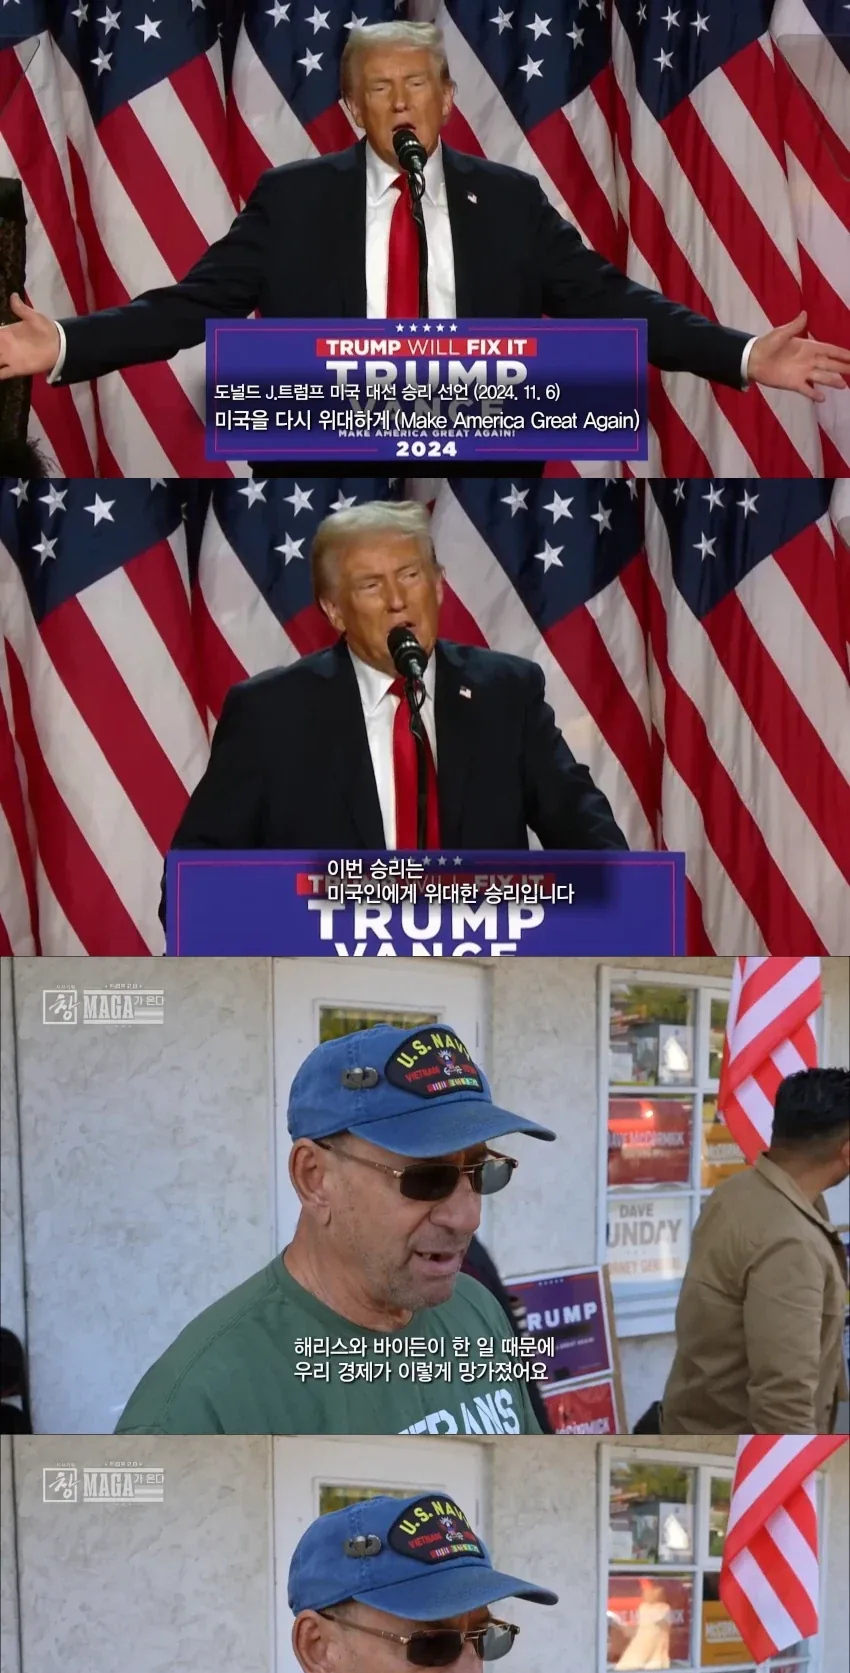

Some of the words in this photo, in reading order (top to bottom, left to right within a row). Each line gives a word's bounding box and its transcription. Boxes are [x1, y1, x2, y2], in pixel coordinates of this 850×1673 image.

[326, 339, 401, 355] TRUMP
[406, 339, 460, 355] WILL
[466, 339, 503, 355] FIX
[507, 339, 528, 355] IT
[326, 360, 528, 391] TRUMP
[395, 441, 458, 457] 2024
[308, 899, 545, 940] TRUMP
[619, 1203, 654, 1218] DAVE
[606, 1219, 683, 1248] UNDAY
